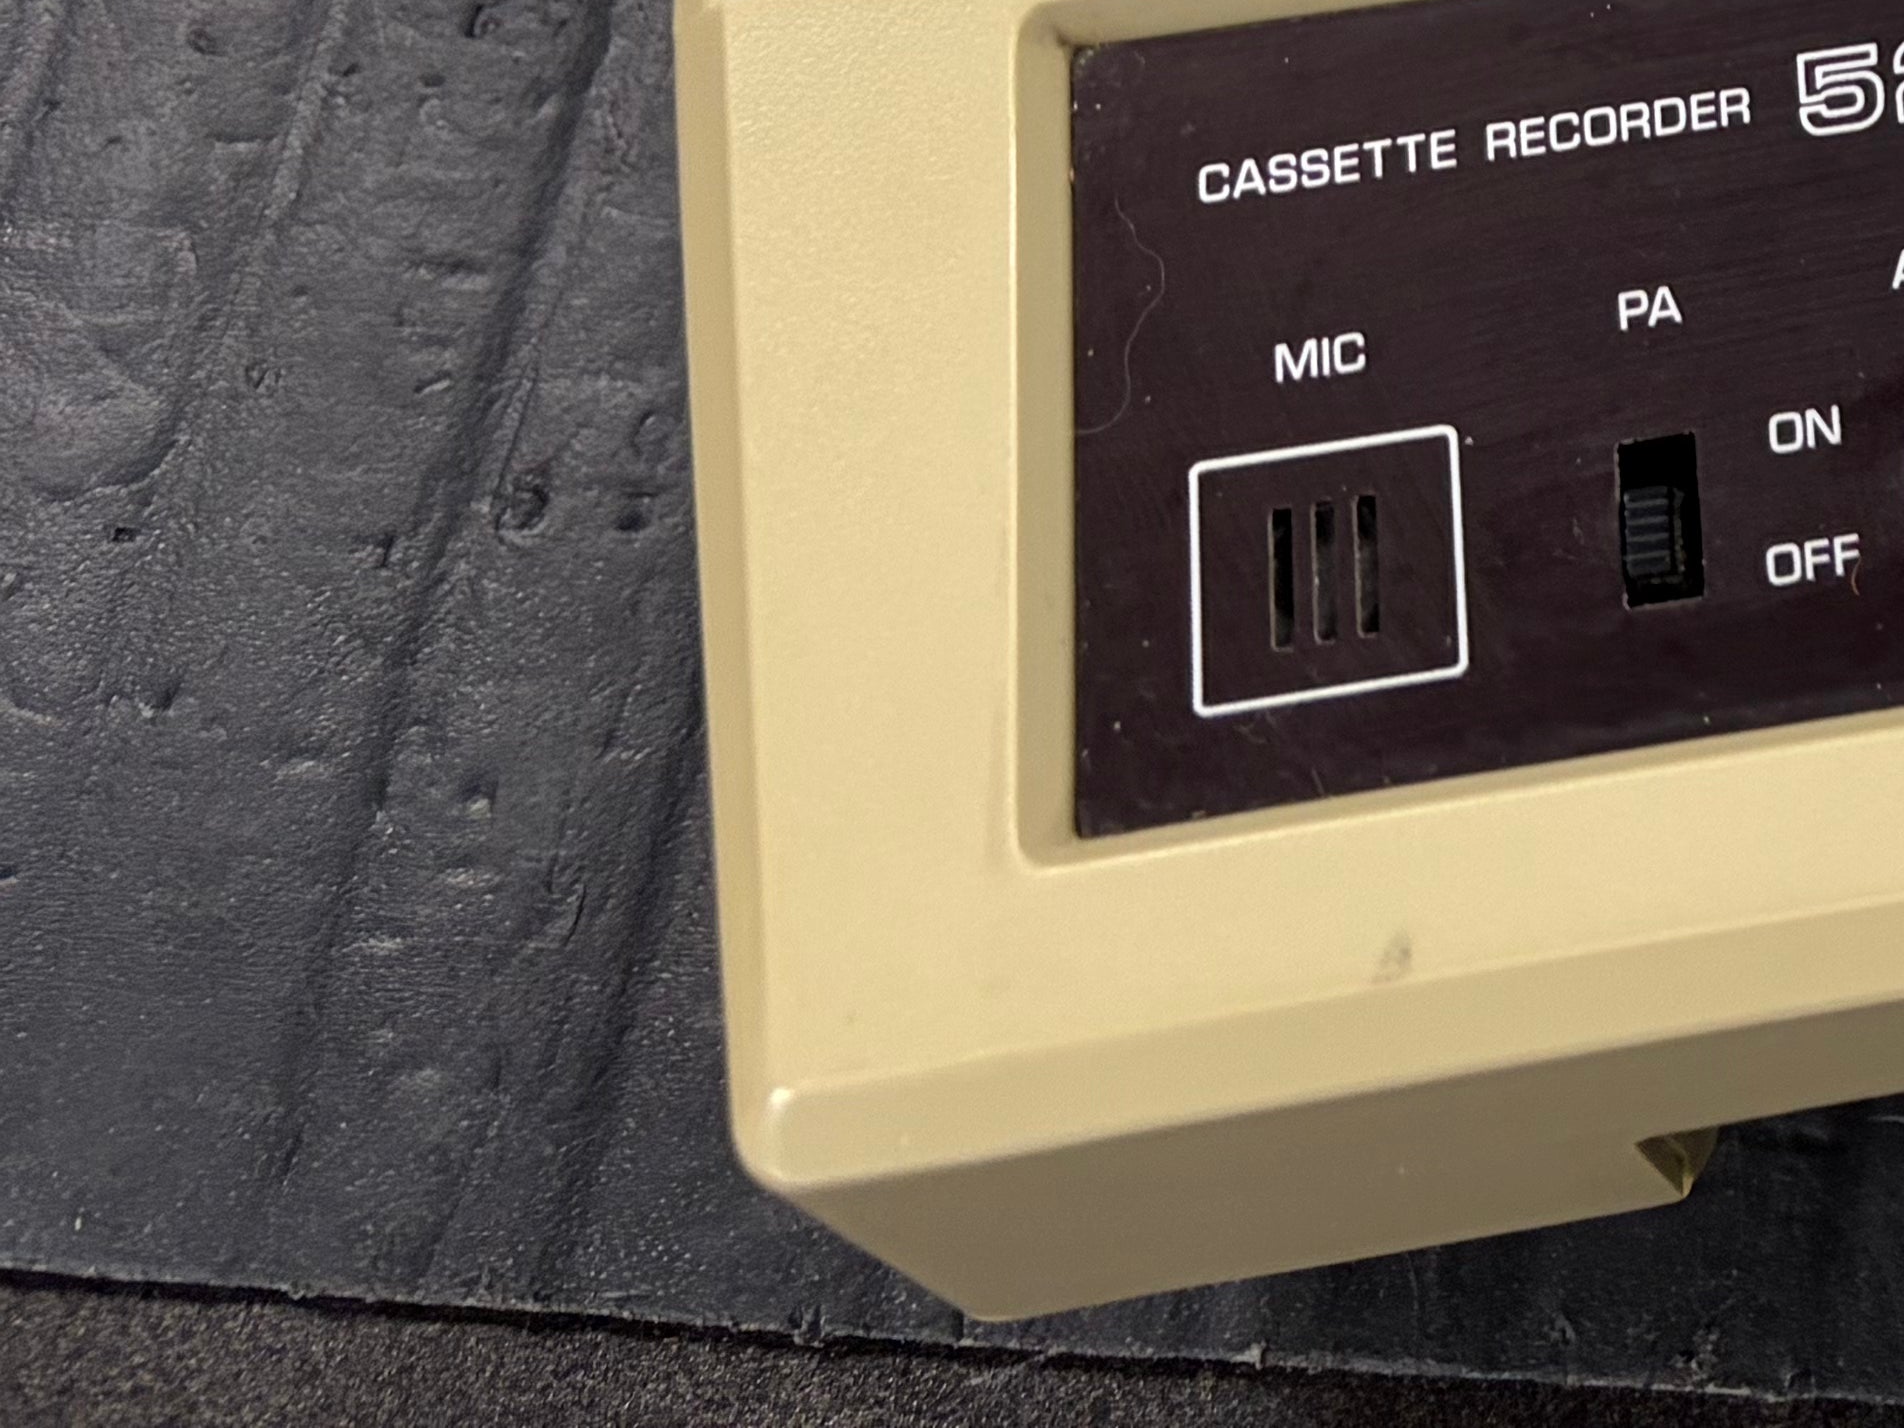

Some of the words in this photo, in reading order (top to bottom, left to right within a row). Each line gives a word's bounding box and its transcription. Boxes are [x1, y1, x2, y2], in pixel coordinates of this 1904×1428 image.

[1198, 129, 1457, 203] CASSETTE
[1485, 87, 1751, 161] RECORDER
[1618, 286, 1682, 331] PA
[1274, 332, 1366, 383] MIC
[1768, 405, 1841, 453] ON
[1766, 533, 1860, 586] OFF
